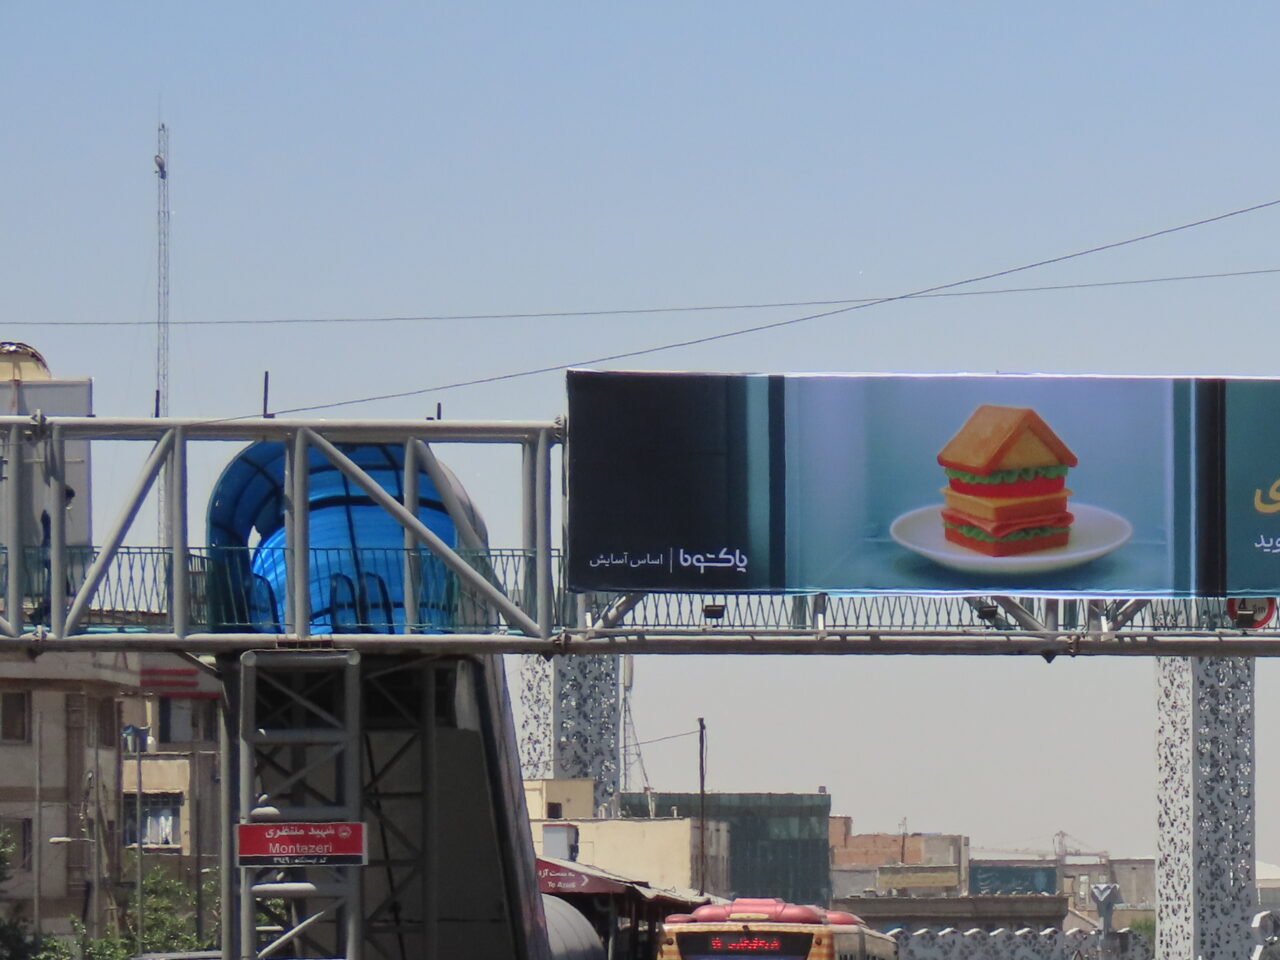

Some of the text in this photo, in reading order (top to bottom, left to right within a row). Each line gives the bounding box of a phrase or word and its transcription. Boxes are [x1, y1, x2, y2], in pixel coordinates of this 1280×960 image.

[588, 552, 663, 568] اساس آسایش
[265, 826, 335, 839] شهید منتظری
[269, 842, 333, 855] Montazeri
